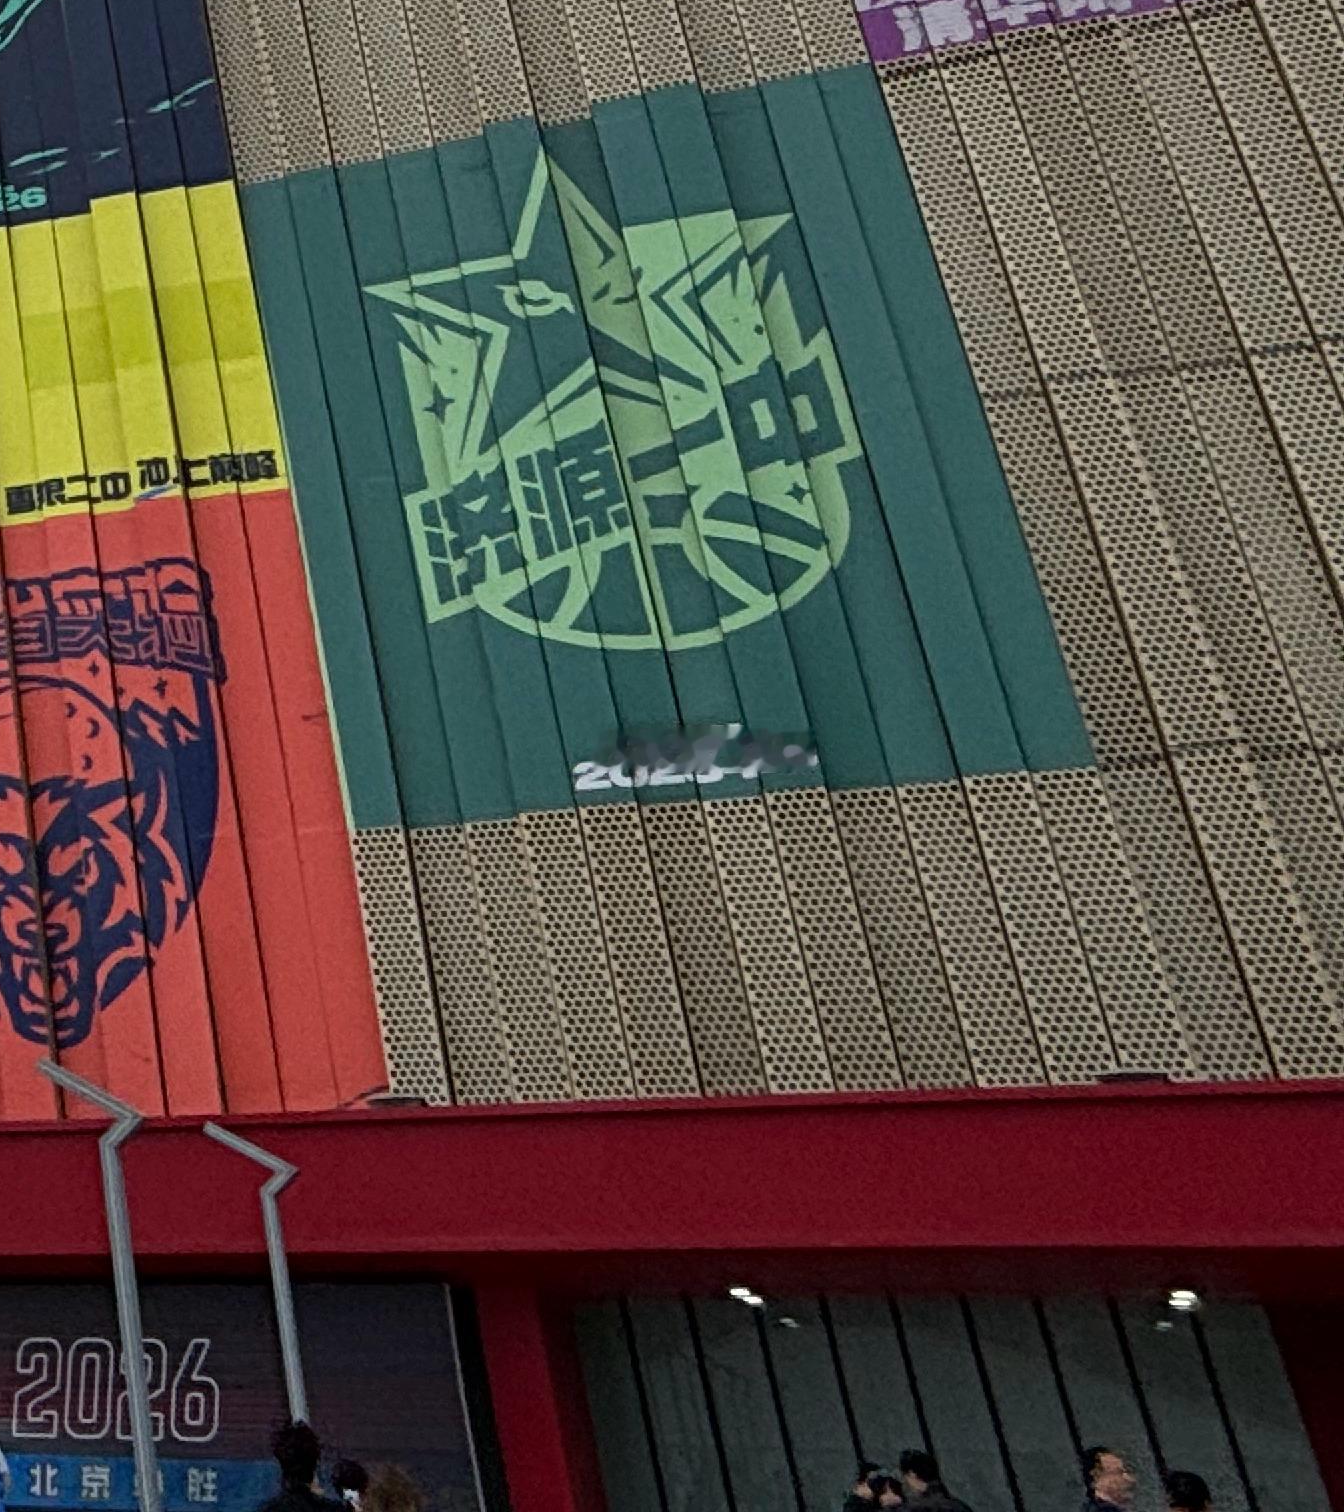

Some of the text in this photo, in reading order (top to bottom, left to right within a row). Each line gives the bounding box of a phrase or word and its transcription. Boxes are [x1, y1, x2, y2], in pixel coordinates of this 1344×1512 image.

[12, 1337, 220, 1443] 2026
[29, 1463, 218, 1502] 北京胜
